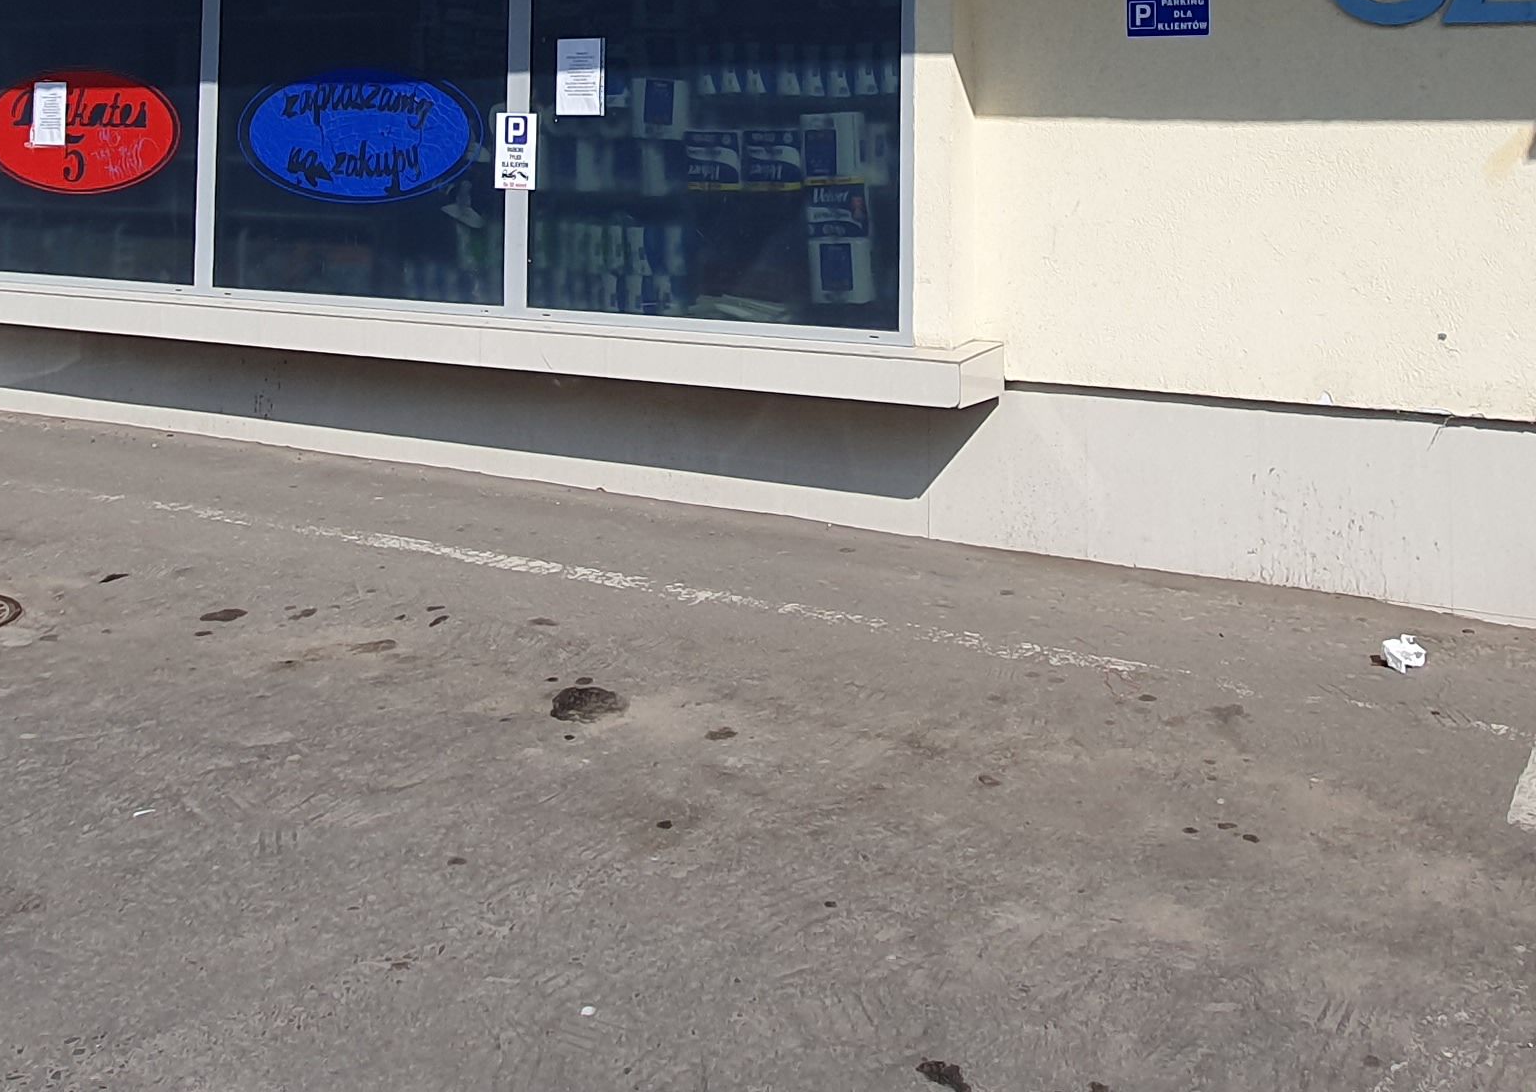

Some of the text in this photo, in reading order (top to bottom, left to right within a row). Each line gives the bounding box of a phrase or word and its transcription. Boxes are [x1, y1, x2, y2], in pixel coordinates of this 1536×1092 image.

[1135, 4, 1152, 27] P
[1173, 10, 1193, 18] DLA
[1157, 20, 1208, 31] KLIENTÓW
[64, 132, 89, 183] 5
